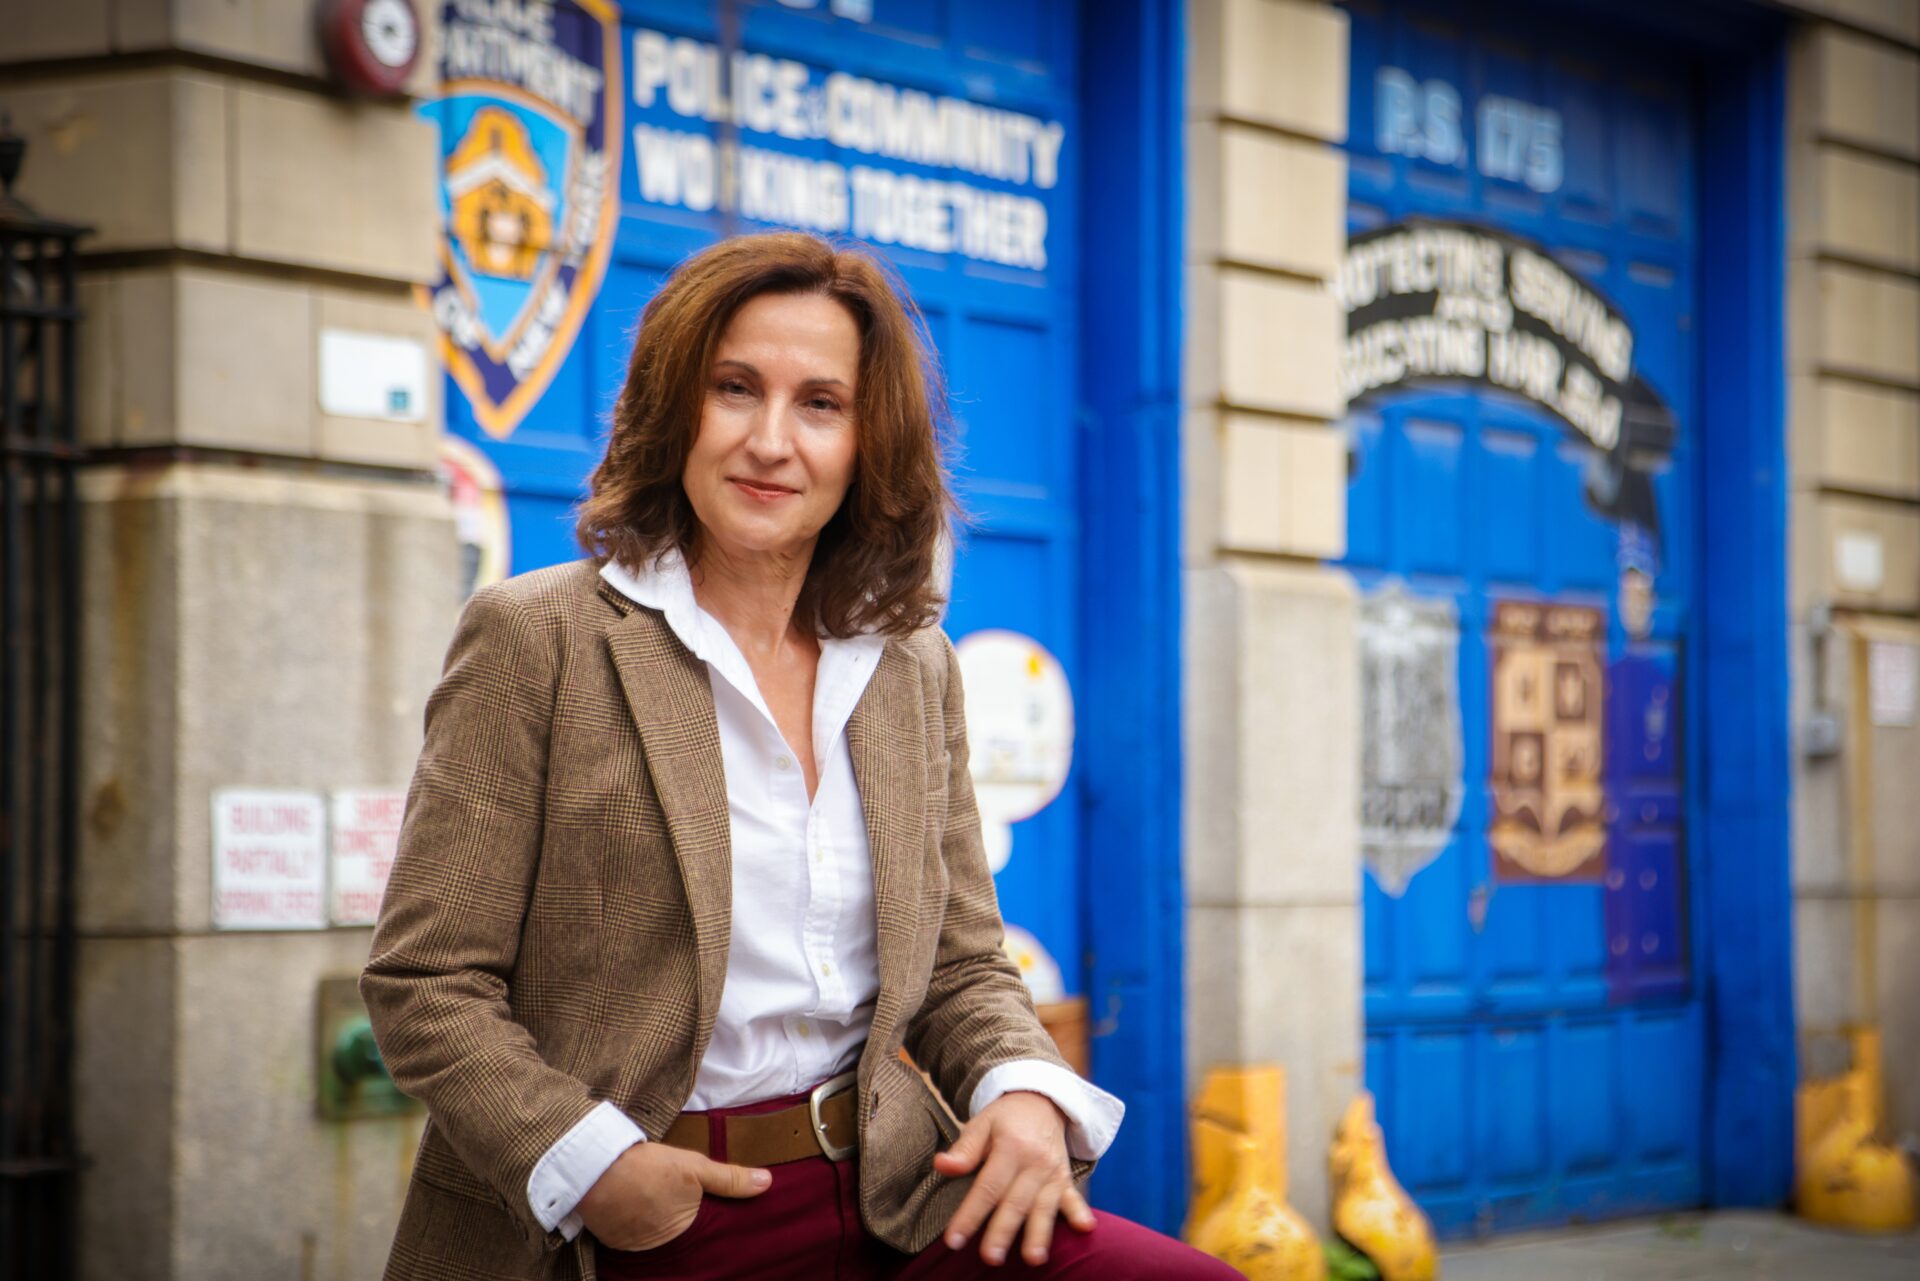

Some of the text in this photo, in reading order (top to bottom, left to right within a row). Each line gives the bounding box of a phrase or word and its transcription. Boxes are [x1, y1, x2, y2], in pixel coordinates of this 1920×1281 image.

[633, 29, 810, 139] POLICE
[826, 71, 1064, 189] COMMUNITY
[850, 165, 1048, 271] TOGETHER
